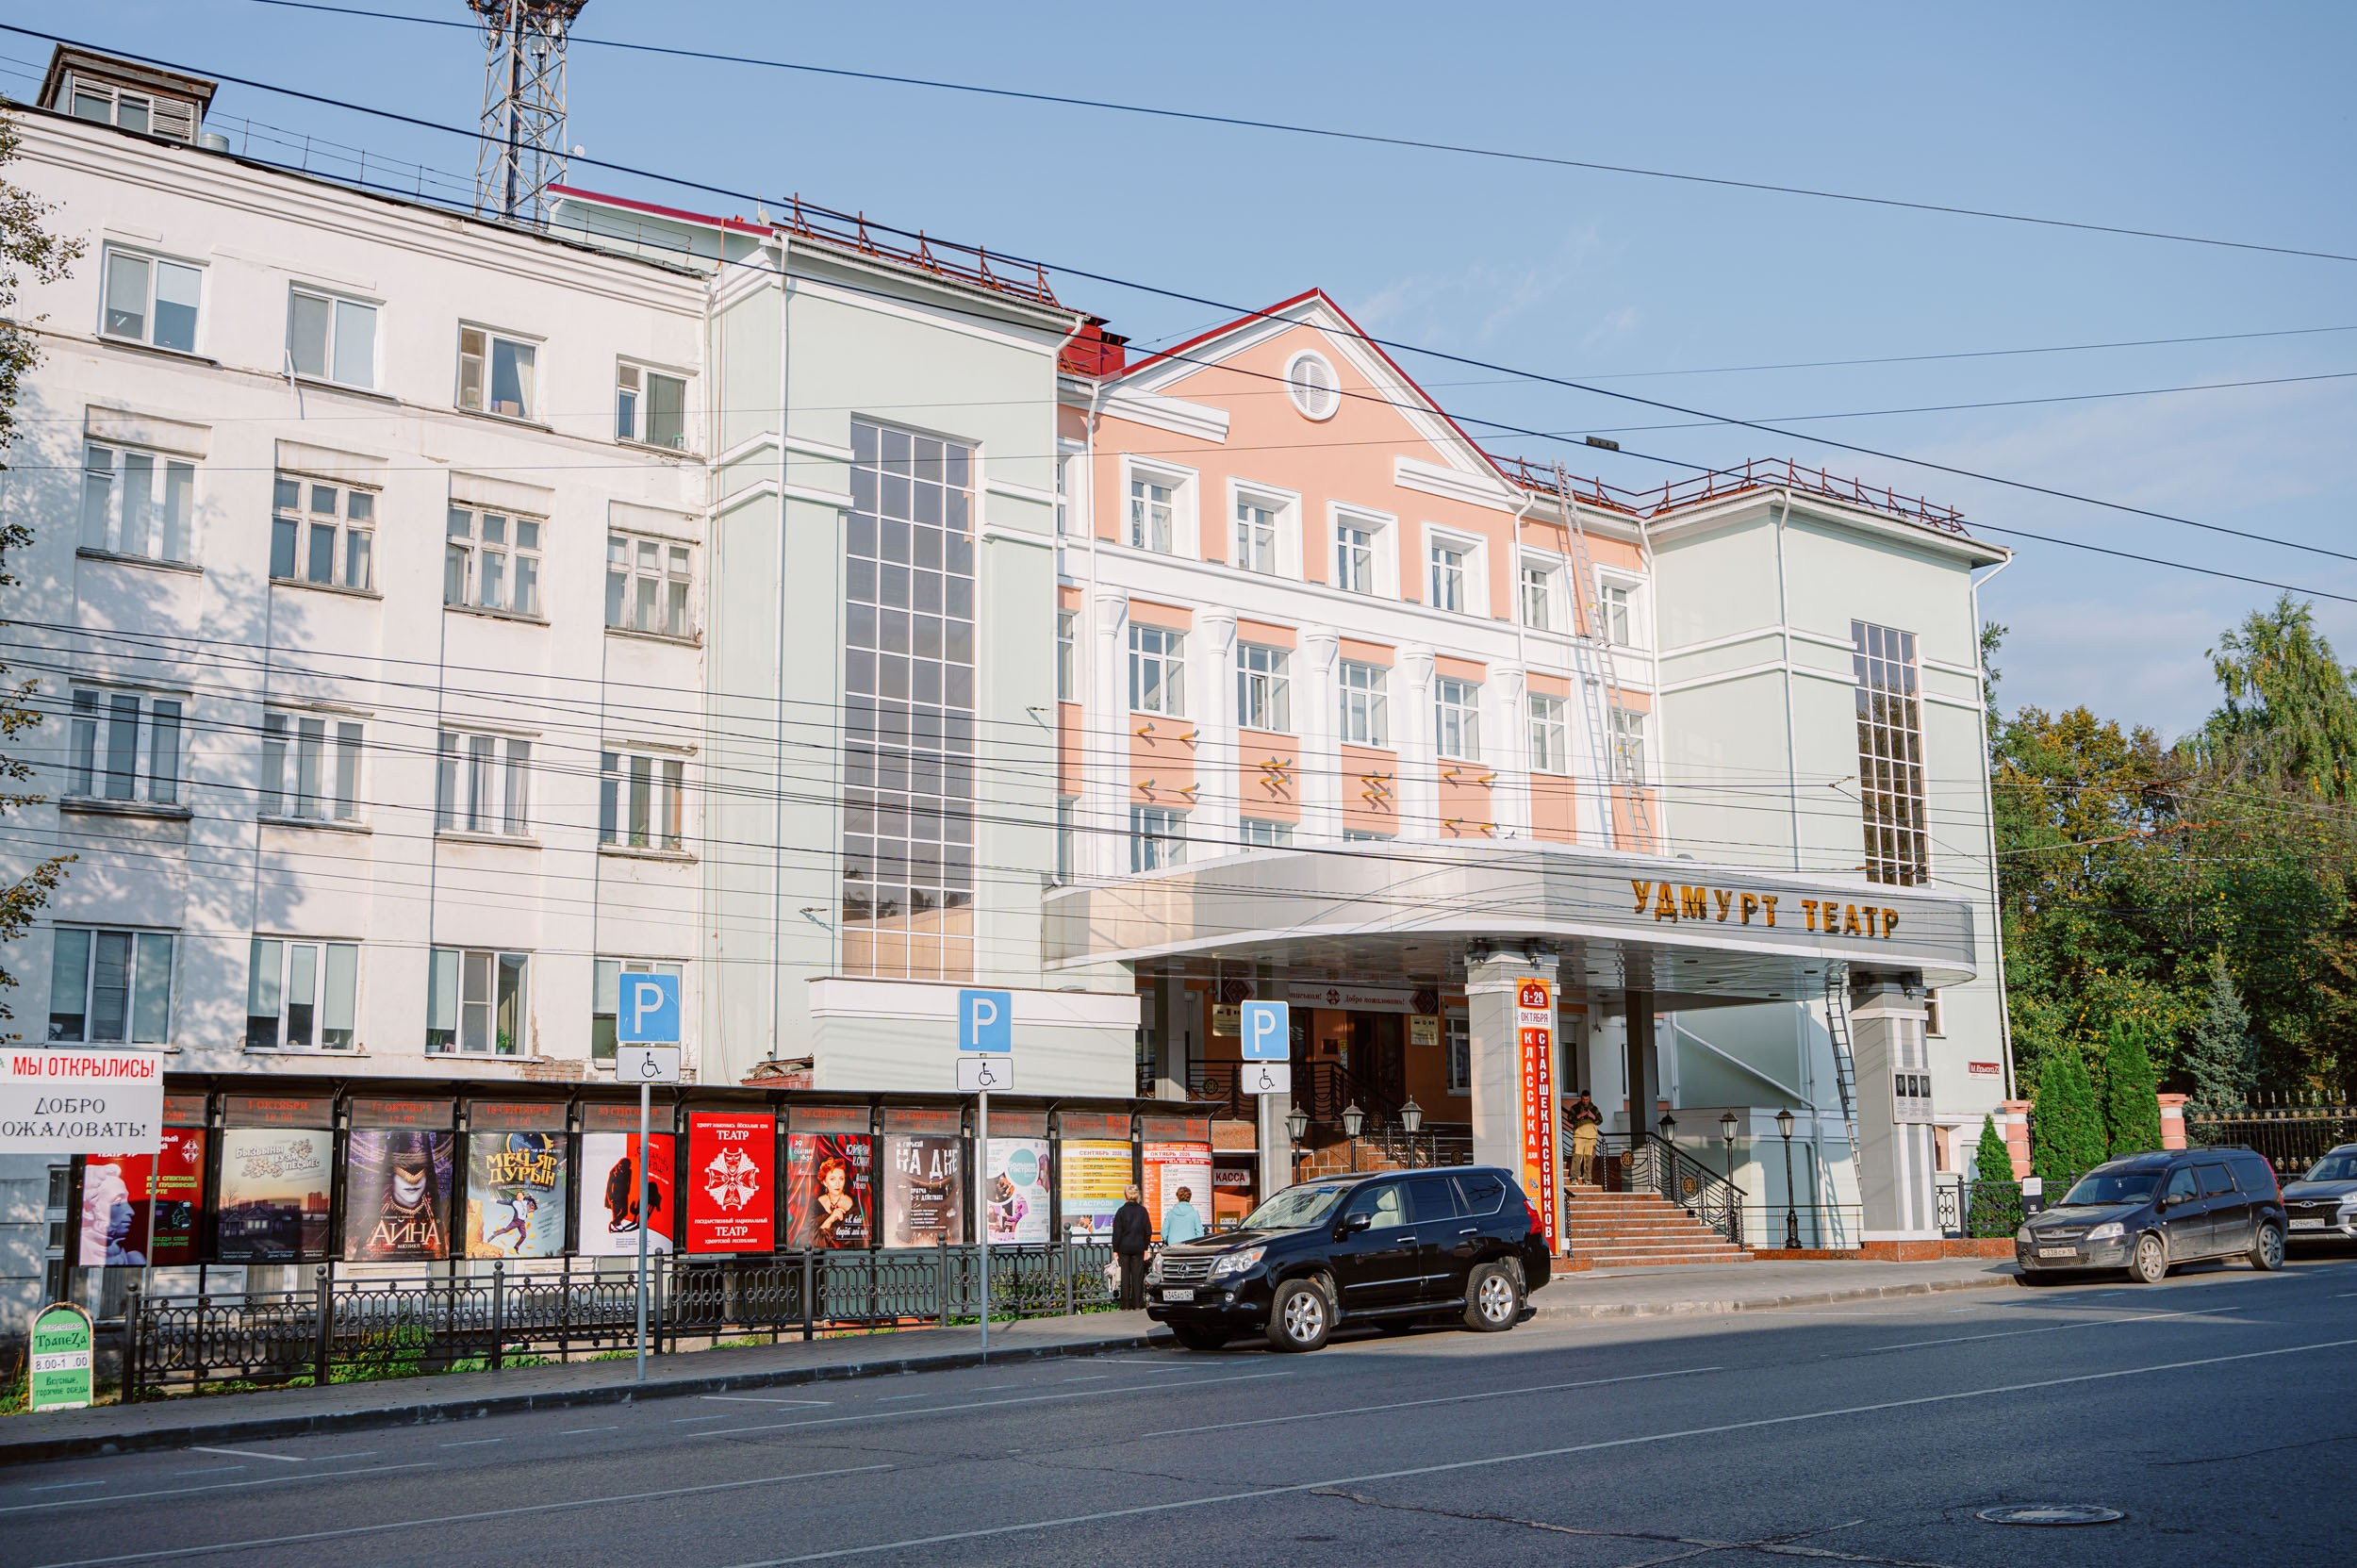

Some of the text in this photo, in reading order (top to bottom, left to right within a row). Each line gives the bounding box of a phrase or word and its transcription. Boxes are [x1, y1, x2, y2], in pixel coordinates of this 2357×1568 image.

[1630, 879, 1900, 939] УДМУРТ ТЕАТР
[635, 982, 664, 1034] P
[1521, 1012, 1548, 1023] ОКТЯБРЯ
[972, 998, 997, 1045] P
[1253, 1009, 1276, 1052] P
[12, 1056, 42, 1076] МЫ
[48, 1056, 155, 1078] ОТКРЫЛИСЬ!
[34, 1097, 106, 1114] ДОБРО
[256, 1100, 308, 1110] ОКТЯБРЯ
[0, 1120, 147, 1138] ОЖАЛОВАТЬ!
[717, 1130, 750, 1140] ТЕАТР
[896, 1148, 921, 1176] НА
[929, 1148, 959, 1180] ДНЕ
[488, 1166, 556, 1186] ДУРЫН
[1215, 1172, 1245, 1182] КАССА
[367, 1217, 441, 1246] АЙНА
[715, 1226, 749, 1236] ТЕАТР
